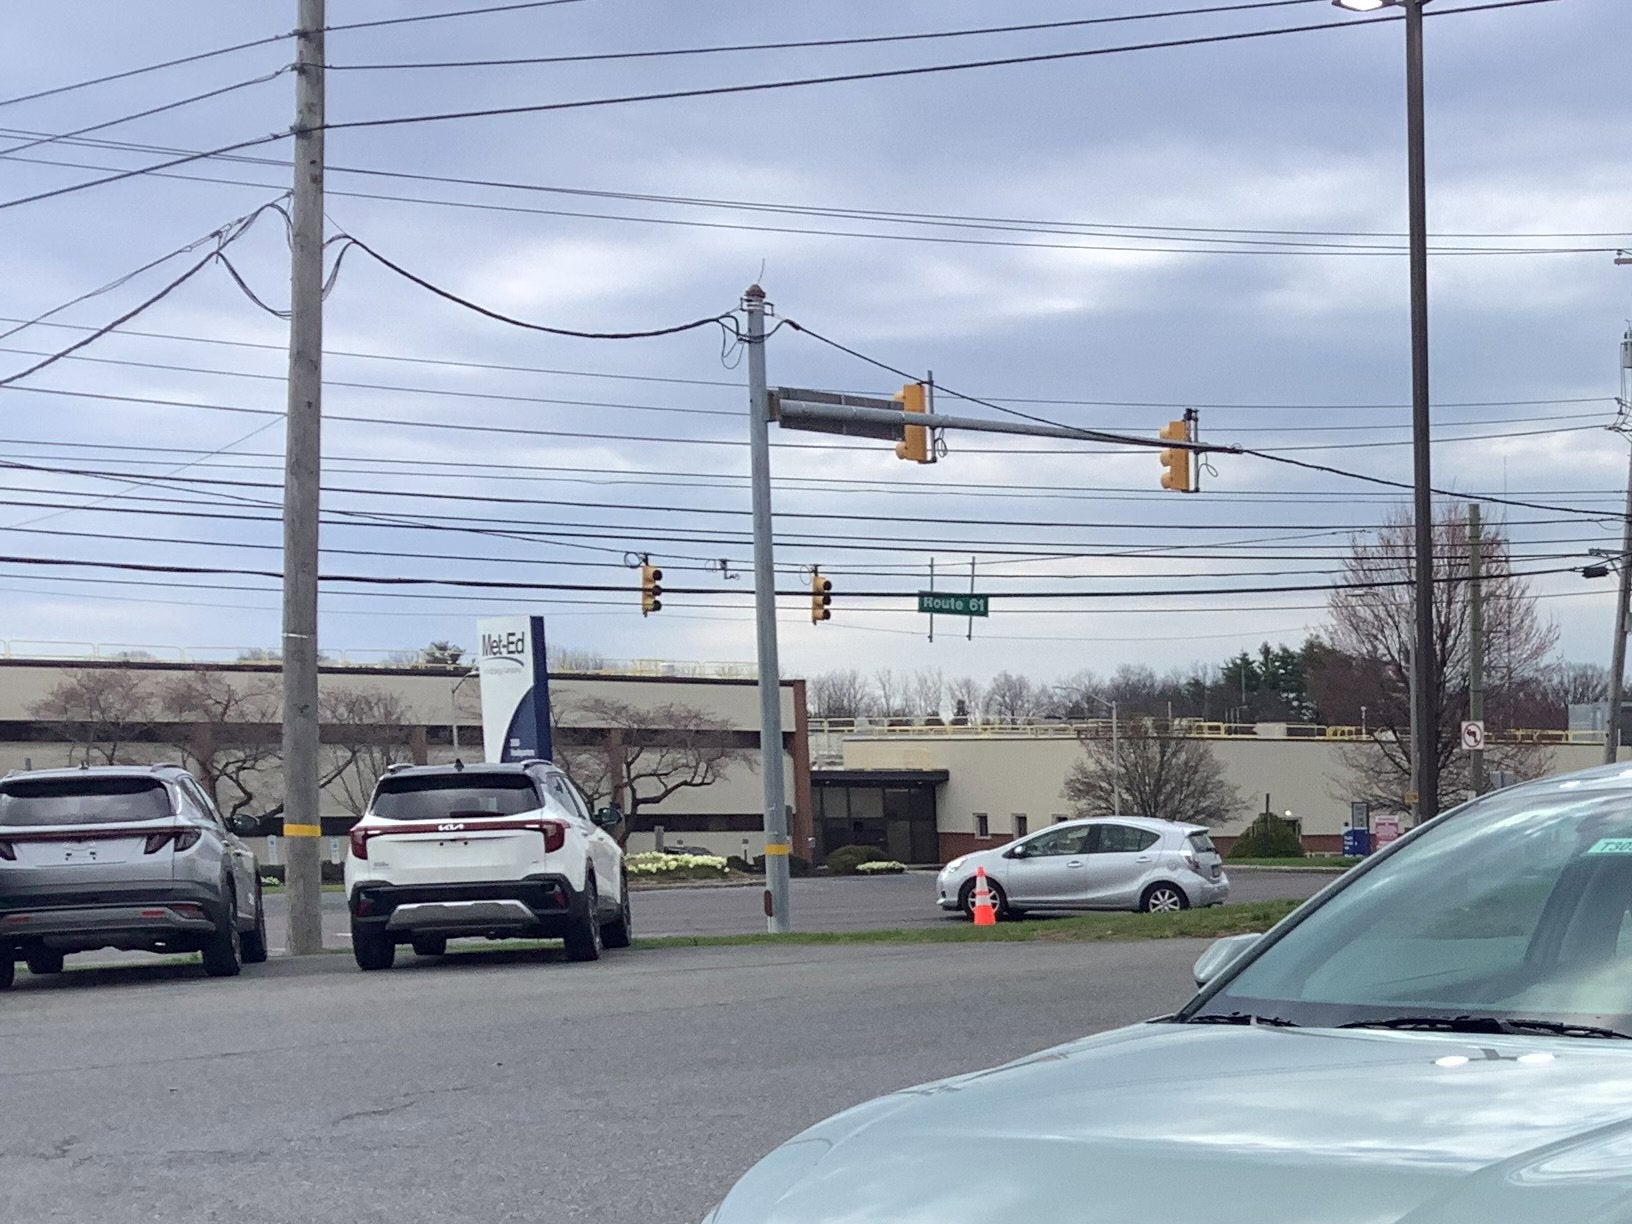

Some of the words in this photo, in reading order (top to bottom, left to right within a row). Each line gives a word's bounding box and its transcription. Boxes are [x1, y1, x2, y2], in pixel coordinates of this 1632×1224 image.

[923, 596, 965, 611] Route
[969, 598, 985, 612] 61
[482, 631, 525, 657] Met-Ed
